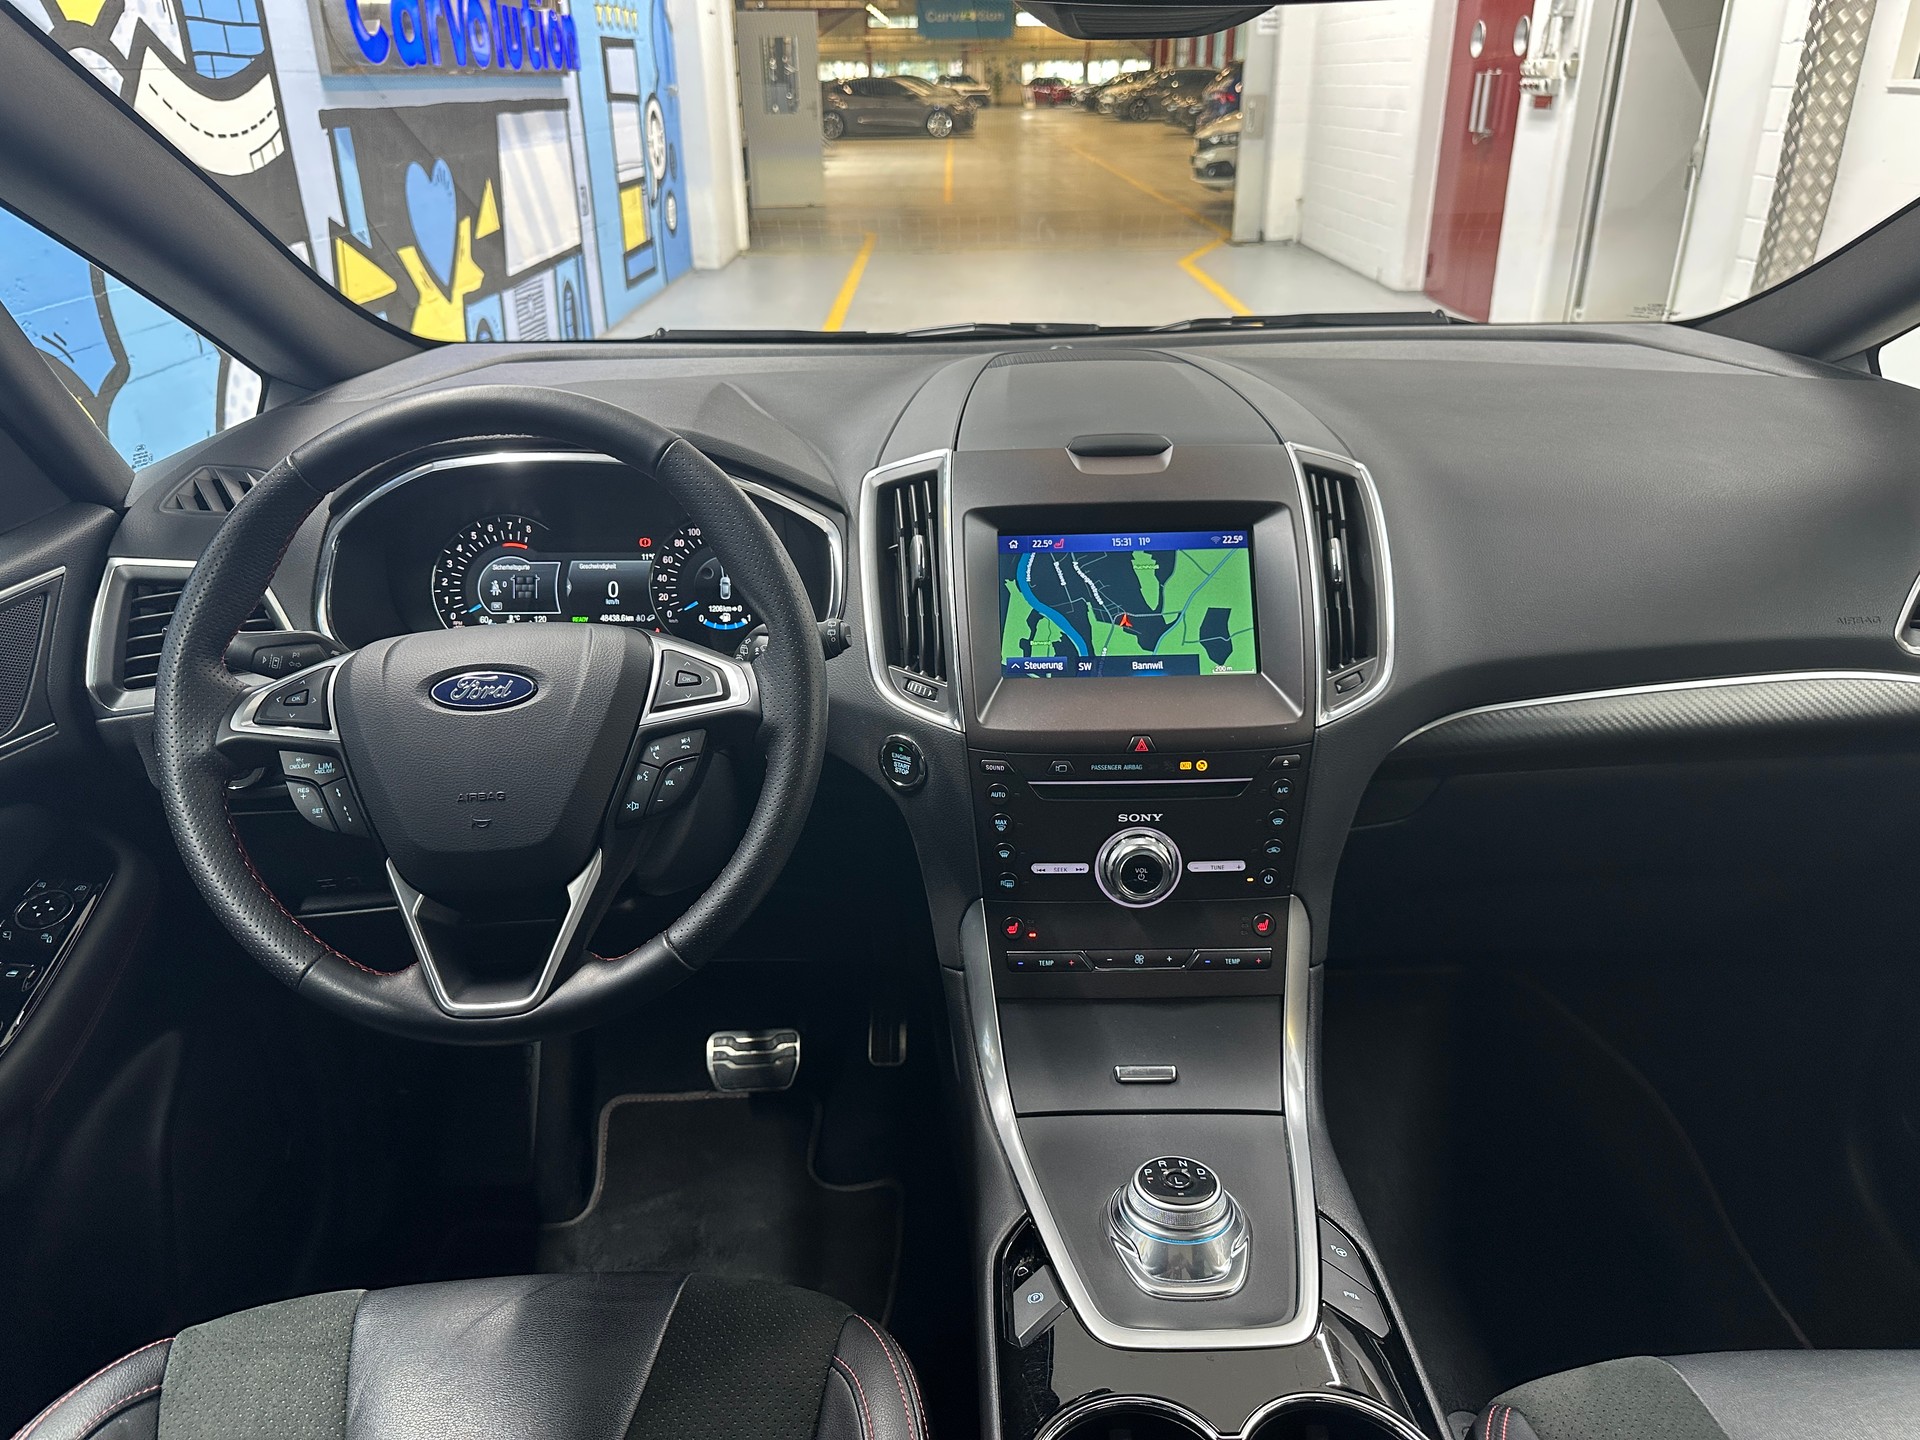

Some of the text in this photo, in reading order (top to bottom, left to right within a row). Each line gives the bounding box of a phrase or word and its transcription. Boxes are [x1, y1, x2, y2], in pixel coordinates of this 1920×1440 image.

[487, 524, 494, 532] 6
[526, 525, 532, 533] 8
[687, 528, 701, 536] 100
[470, 531, 477, 540] 5
[674, 539, 685, 547] 80
[1112, 537, 1132, 546] 15:31
[456, 544, 463, 552] 4
[446, 560, 453, 568] 3
[662, 556, 673, 564] 60
[442, 578, 449, 586] 2
[657, 574, 668, 582] 40
[607, 580, 619, 598] 0
[658, 592, 669, 601] 20
[479, 616, 490, 624] 60
[534, 615, 548, 623] 120
[1024, 661, 1064, 671] Steuerung
[1078, 662, 1092, 671] SW
[1132, 661, 1164, 670] Bannwil
[450, 675, 514, 701] Ford
[892, 752, 912, 763] ENGINE
[893, 761, 910, 770] START
[895, 767, 910, 775] STOP
[456, 791, 507, 803] AIRBAG
[1117, 813, 1164, 823] SONY
[1038, 959, 1055, 967] TEMP
[1224, 957, 1241, 965] TEMP
[1174, 1176, 1183, 1184] L
